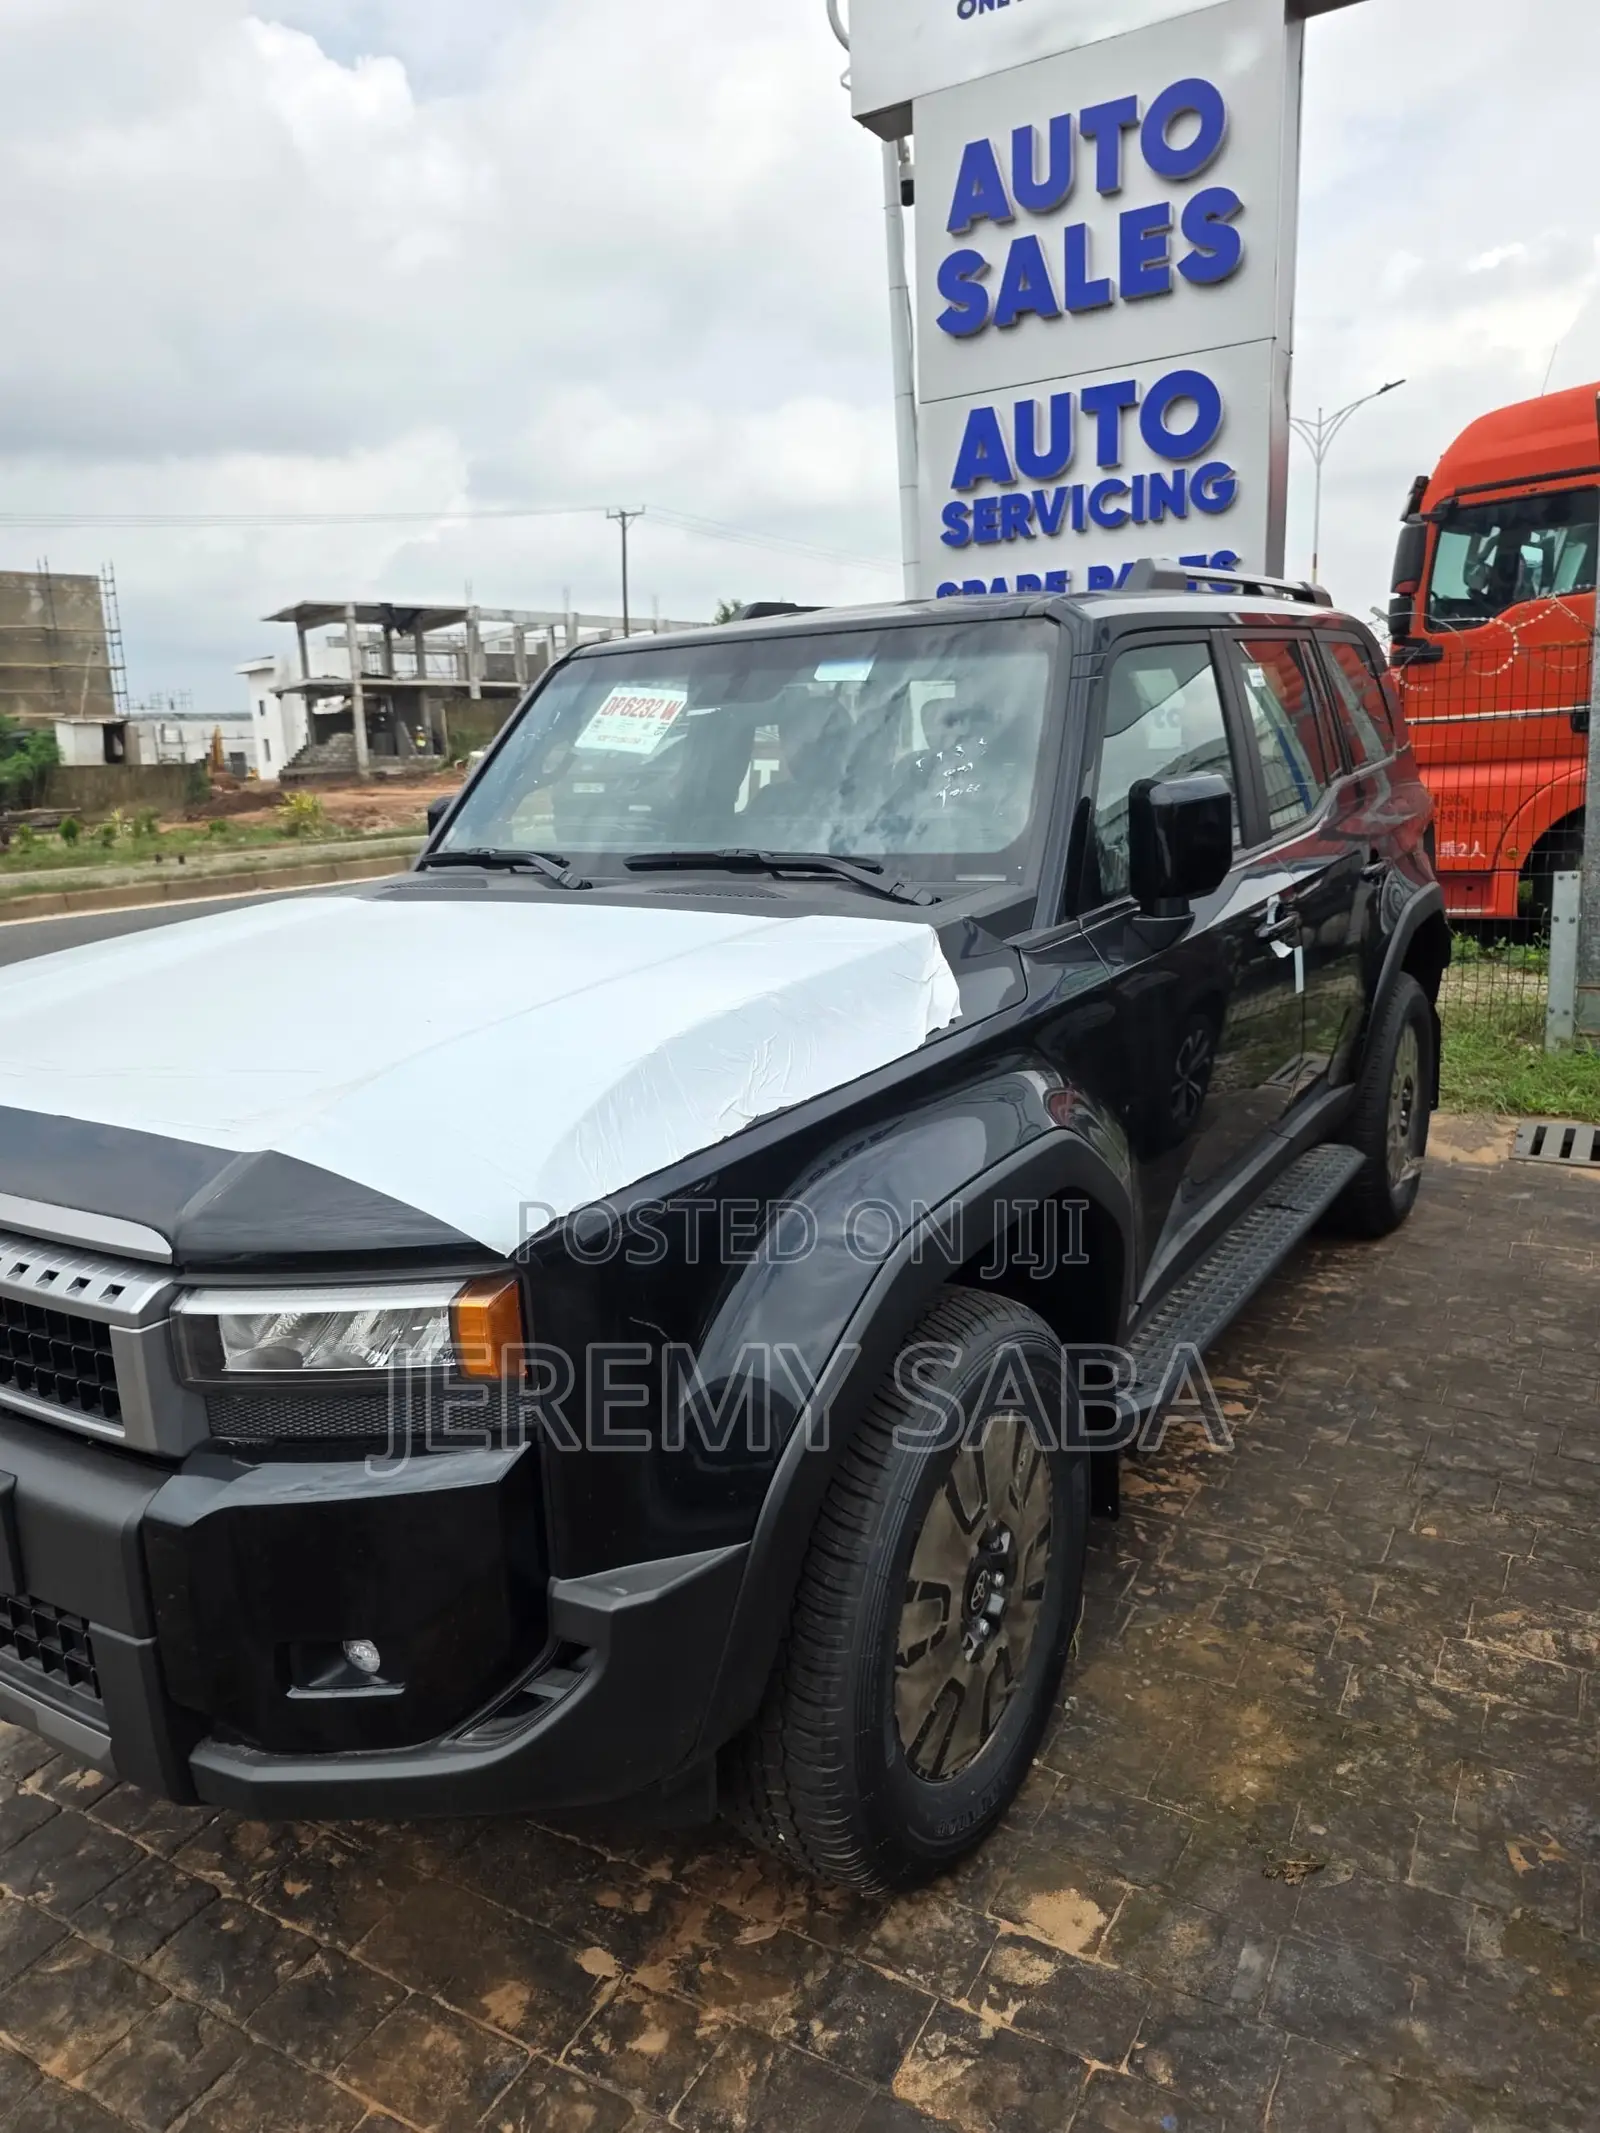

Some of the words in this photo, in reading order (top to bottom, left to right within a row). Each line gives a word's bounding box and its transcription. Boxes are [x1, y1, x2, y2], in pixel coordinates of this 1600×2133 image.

[946, 77, 1227, 235] AUTO
[936, 187, 1246, 338] SALES
[950, 369, 1224, 491] AUTO
[939, 461, 1238, 548] SERVICING
